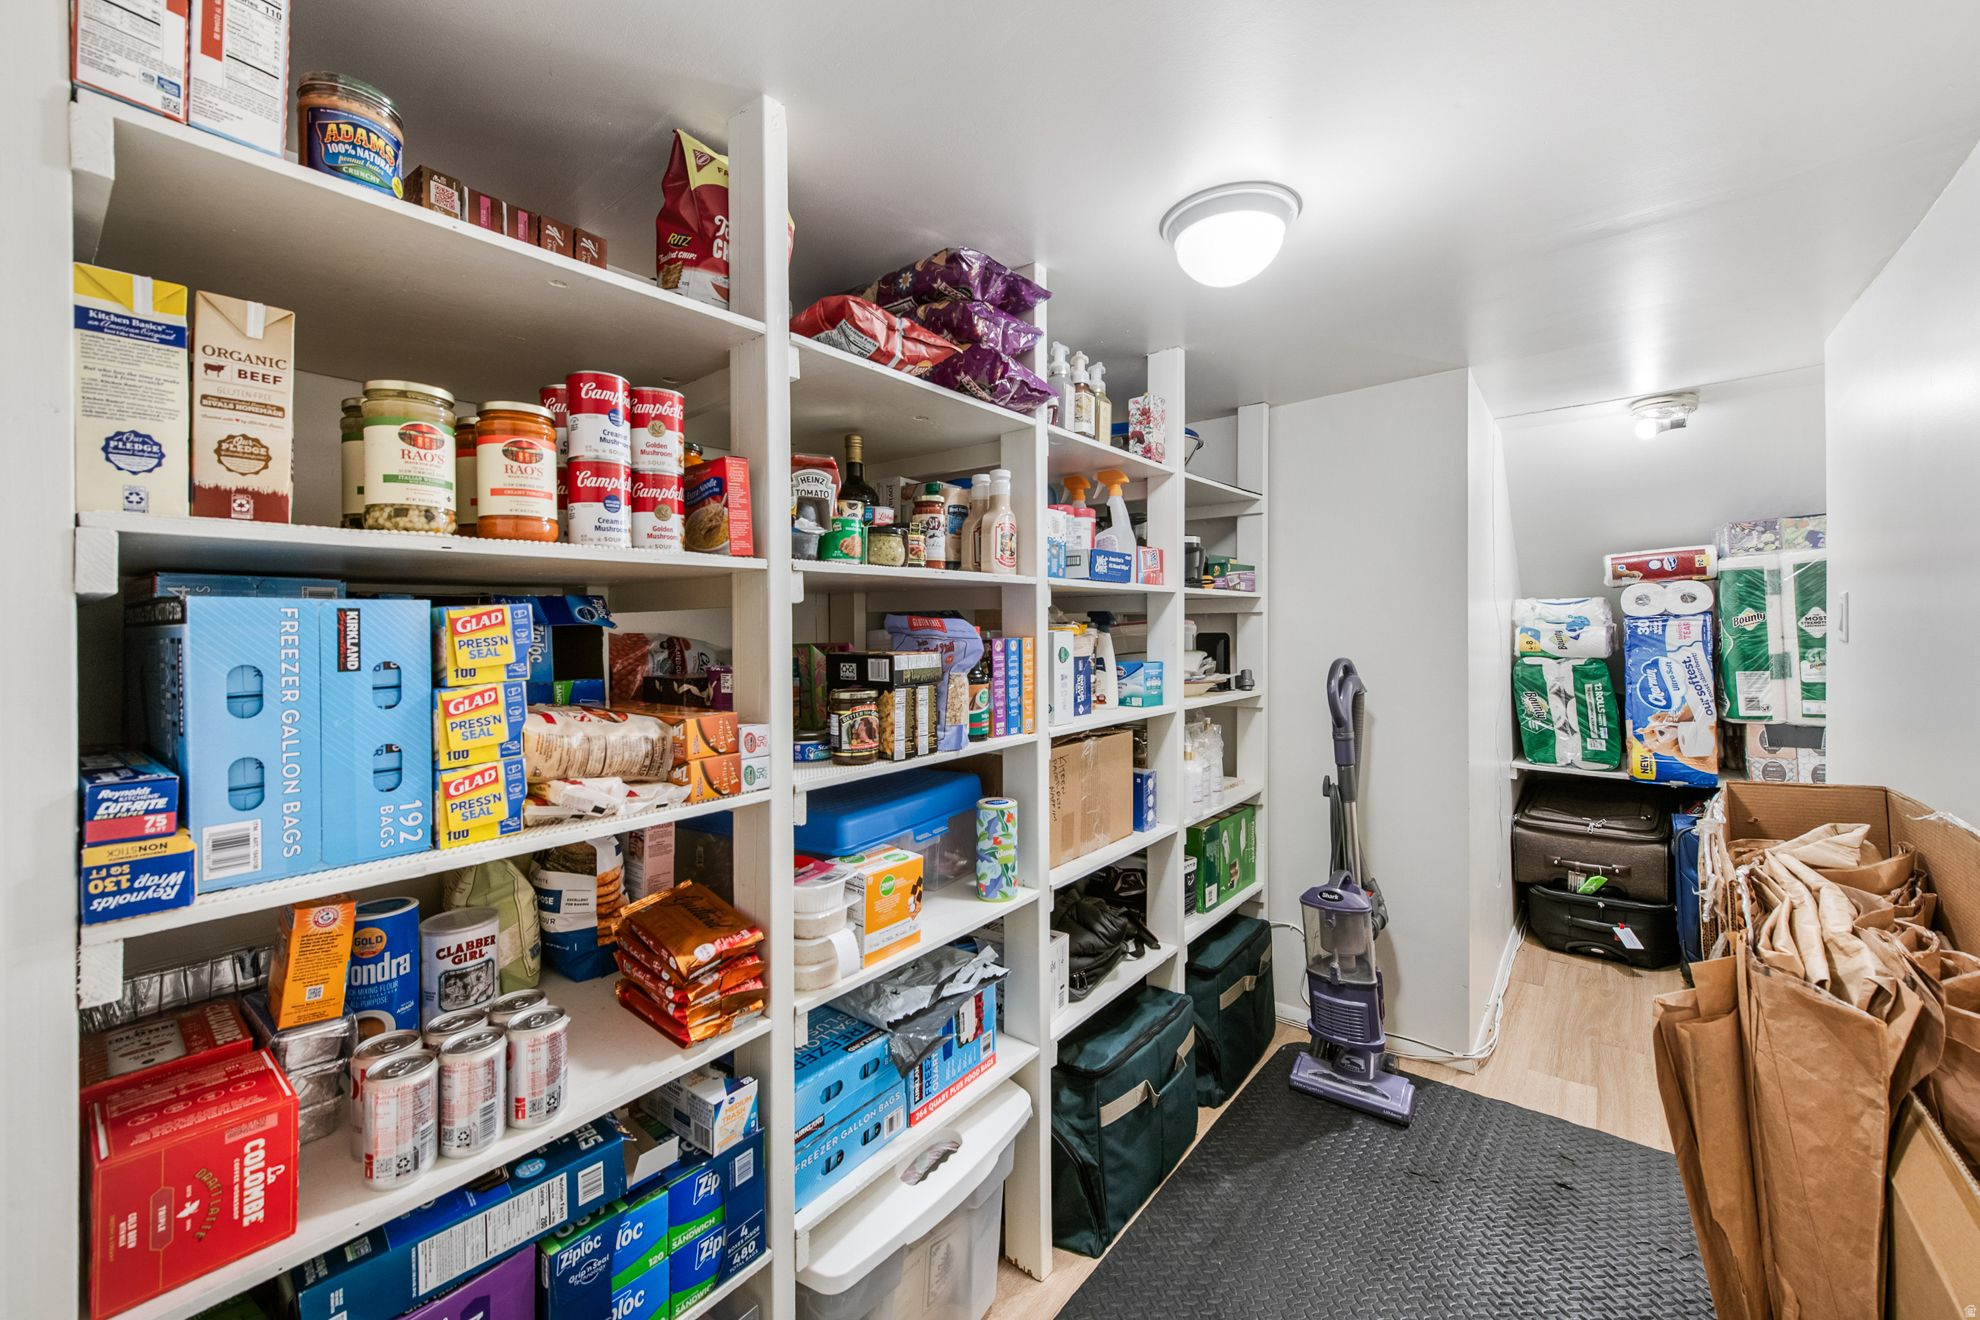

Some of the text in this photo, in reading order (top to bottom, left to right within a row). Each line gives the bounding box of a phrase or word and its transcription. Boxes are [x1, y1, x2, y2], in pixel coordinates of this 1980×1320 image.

[265, 6, 282, 21] 110
[325, 124, 395, 167] ADAMS
[327, 143, 397, 177] 100% NATURAL
[342, 166, 381, 184] CRUNCHY
[667, 233, 692, 247] RITZ
[89, 310, 130, 326] Kitchen
[202, 345, 287, 370] ORGANIC
[238, 369, 283, 385] BEEF
[110, 441, 161, 453] PLEDGE
[221, 442, 268, 456] PLEDGE
[645, 441, 668, 450] Golden
[400, 449, 445, 464] RAO'S
[504, 464, 544, 477] RAO'S
[800, 475, 825, 486] HEINZ
[796, 489, 829, 499] TOMATO
[652, 525, 673, 534] Golden
[455, 611, 503, 634] GLAD
[1732, 613, 1768, 628] Bounty
[346, 610, 360, 669] KIRKLAND
[457, 636, 508, 650] PRESS'N
[468, 648, 501, 660] SEAL
[454, 668, 477, 679] 100
[1666, 660, 1681, 692] Ultra Soft
[1682, 655, 1705, 697] softest,
[1646, 668, 1667, 707] Charmin
[448, 692, 497, 715] GLAD
[1524, 692, 1546, 719] Bounty
[1593, 683, 1606, 716] 12 ROLLS
[281, 607, 301, 858] FREEZER GALLON BAGS
[450, 714, 502, 732] PRESS'N
[461, 728, 494, 741] SEAL
[446, 750, 470, 761] 100
[1639, 755, 1650, 775] NEW
[448, 770, 497, 796] GLAD
[97, 787, 152, 801] Reynolds
[450, 793, 502, 813] PRESS'N
[144, 815, 168, 829] 75
[399, 800, 424, 845] 192
[461, 806, 494, 821] SEAL
[380, 804, 395, 849] BAGS
[446, 829, 470, 841] 100
[89, 864, 131, 880] SQ FT
[135, 871, 186, 891] Wrap
[88, 878, 131, 895] 130
[90, 885, 181, 912] Reynolds
[1321, 892, 1339, 901] Shark
[354, 934, 383, 947] GOLD
[436, 935, 496, 960] CLABBER
[452, 950, 487, 965] GIRL
[351, 952, 411, 986] ondra
[915, 1059, 995, 1126] 264 QUART PLUS FOOD BAGS
[722, 1106, 747, 1123] TRASH
[724, 1095, 753, 1115] MEDIUM
[795, 1092, 902, 1170] FREEZER GALLON BAGS
[232, 1157, 241, 1183] COFFEE
[242, 1138, 268, 1227] COLOMBE
[194, 1168, 223, 1242] DRAFT LATTE
[157, 1204, 169, 1233] TRIPLE
[615, 1222, 644, 1251] loc
[672, 1217, 716, 1251] SANDWICH
[727, 1226, 761, 1255] BOXES INSIDE
[739, 1225, 748, 1241] 4
[560, 1236, 602, 1271] Ziploc
[647, 1251, 665, 1268] 120
[732, 1240, 757, 1266] 480
[568, 1268, 587, 1286] Grip
[729, 1259, 746, 1276] TOTAL
[675, 1282, 715, 1318] SANDWIC
